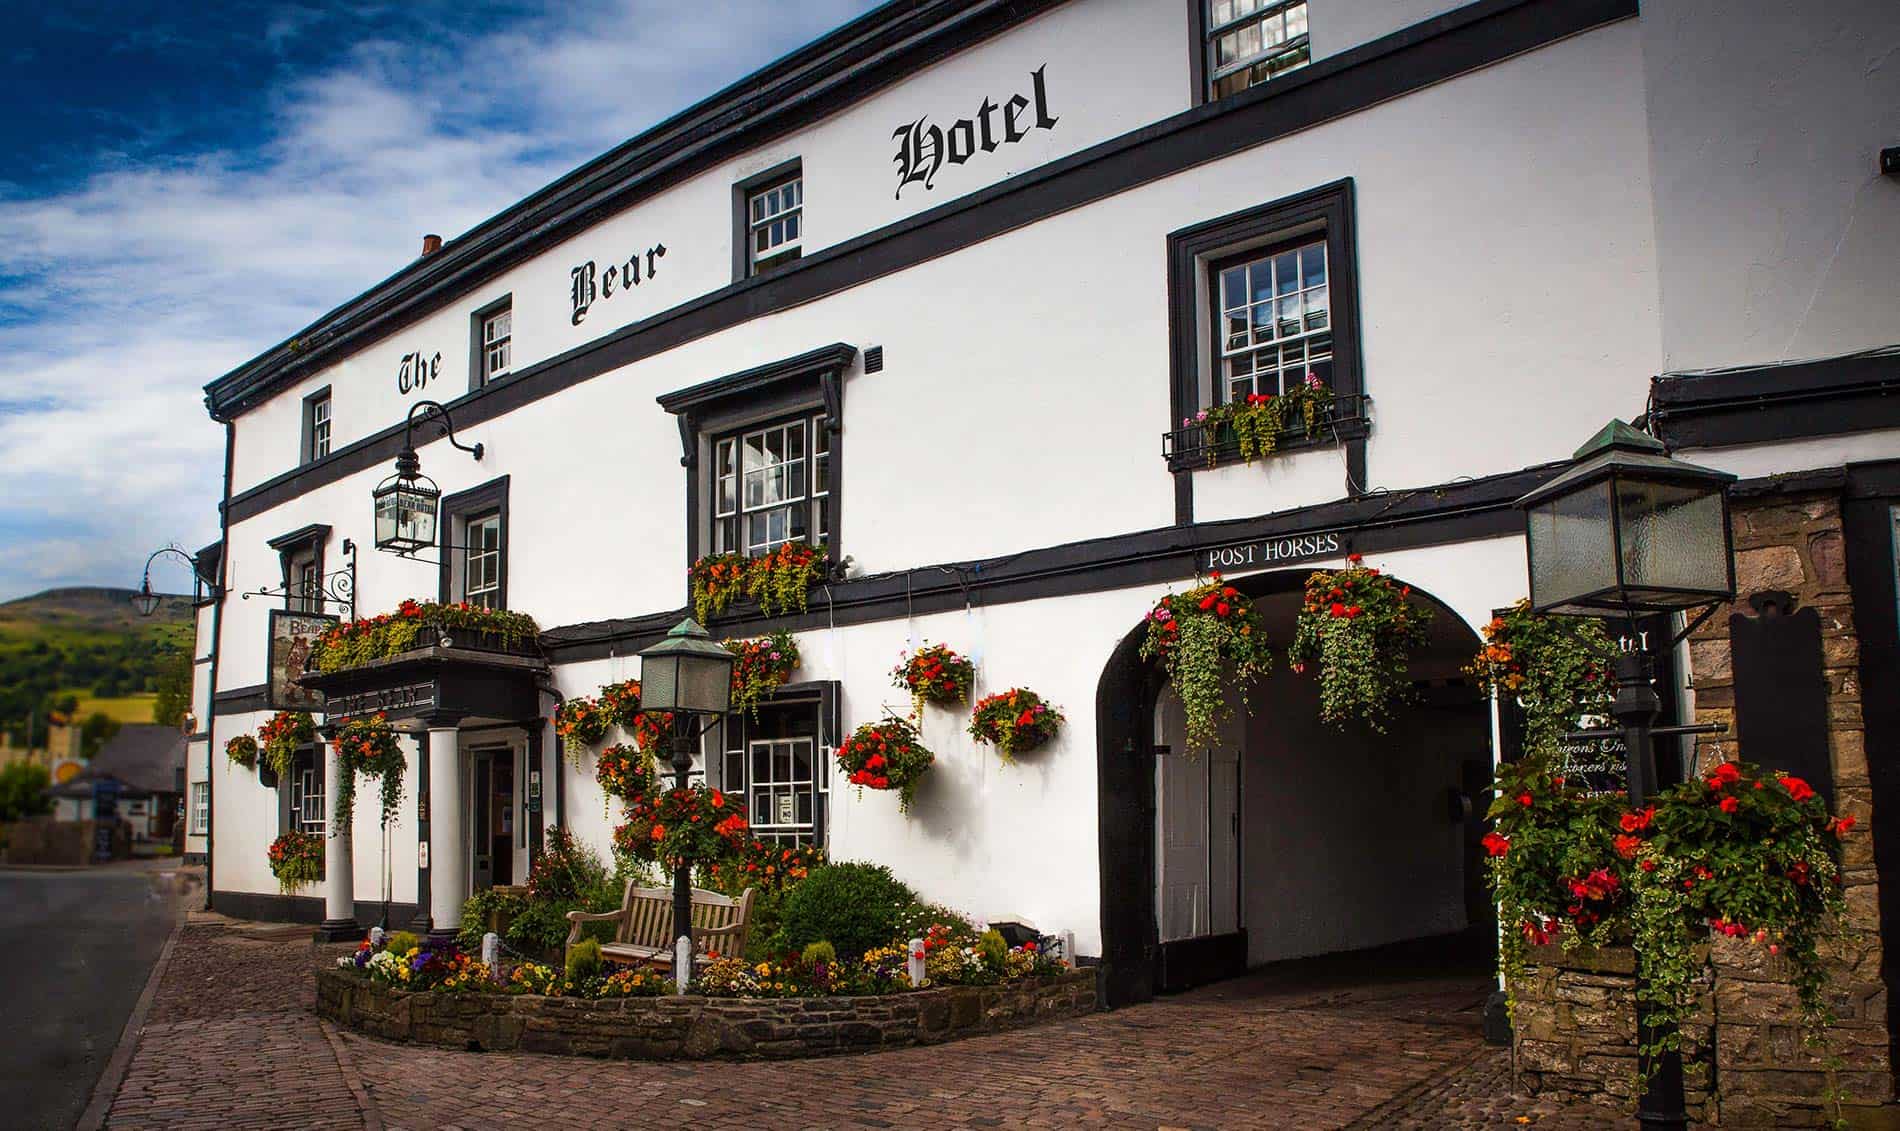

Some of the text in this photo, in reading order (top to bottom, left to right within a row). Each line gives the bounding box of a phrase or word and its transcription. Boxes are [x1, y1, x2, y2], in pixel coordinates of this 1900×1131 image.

[399, 63, 1060, 395] The Bear Hotel
[1208, 532, 1339, 568] POST HORSES
